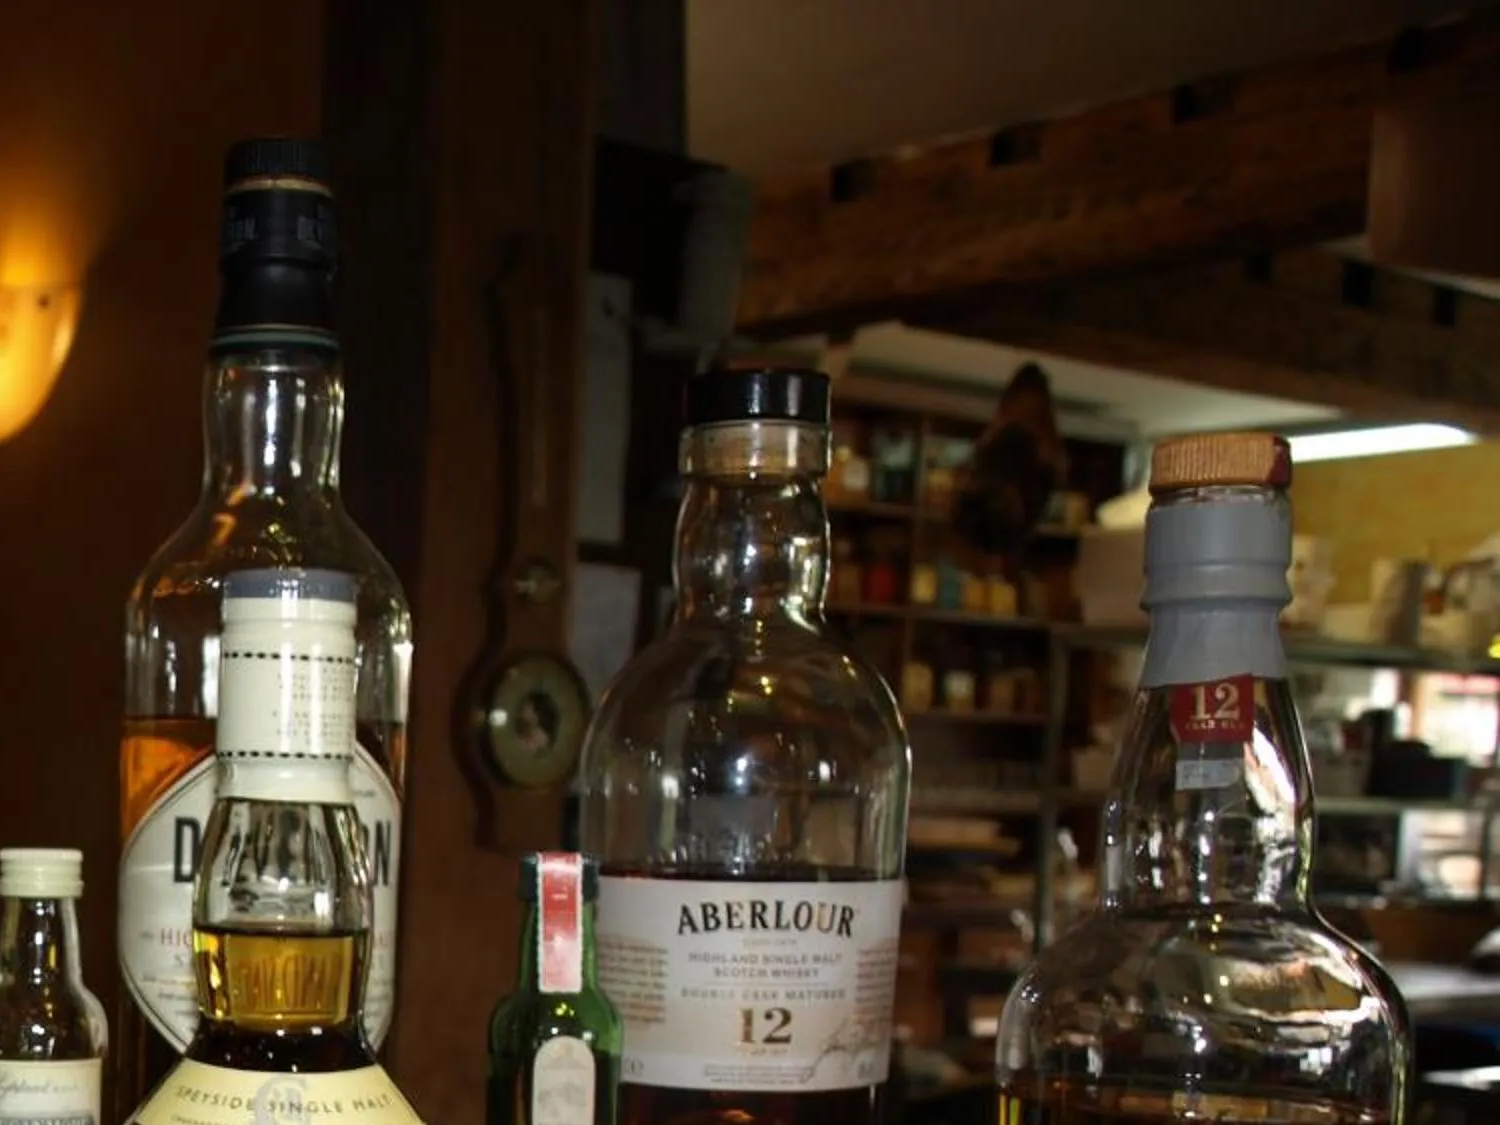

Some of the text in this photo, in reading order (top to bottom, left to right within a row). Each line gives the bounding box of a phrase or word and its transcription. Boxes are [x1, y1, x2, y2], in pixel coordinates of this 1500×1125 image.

[1189, 682, 1240, 720] 12
[676, 899, 855, 937] ABERLOUR
[687, 951, 843, 965] HIGHLAND SINGLE MALT
[713, 966, 821, 979] SCOTCH WHISKY
[738, 1006, 794, 1046] 12
[175, 1085, 393, 1115] SPEYSIDE SINGLE MALT
